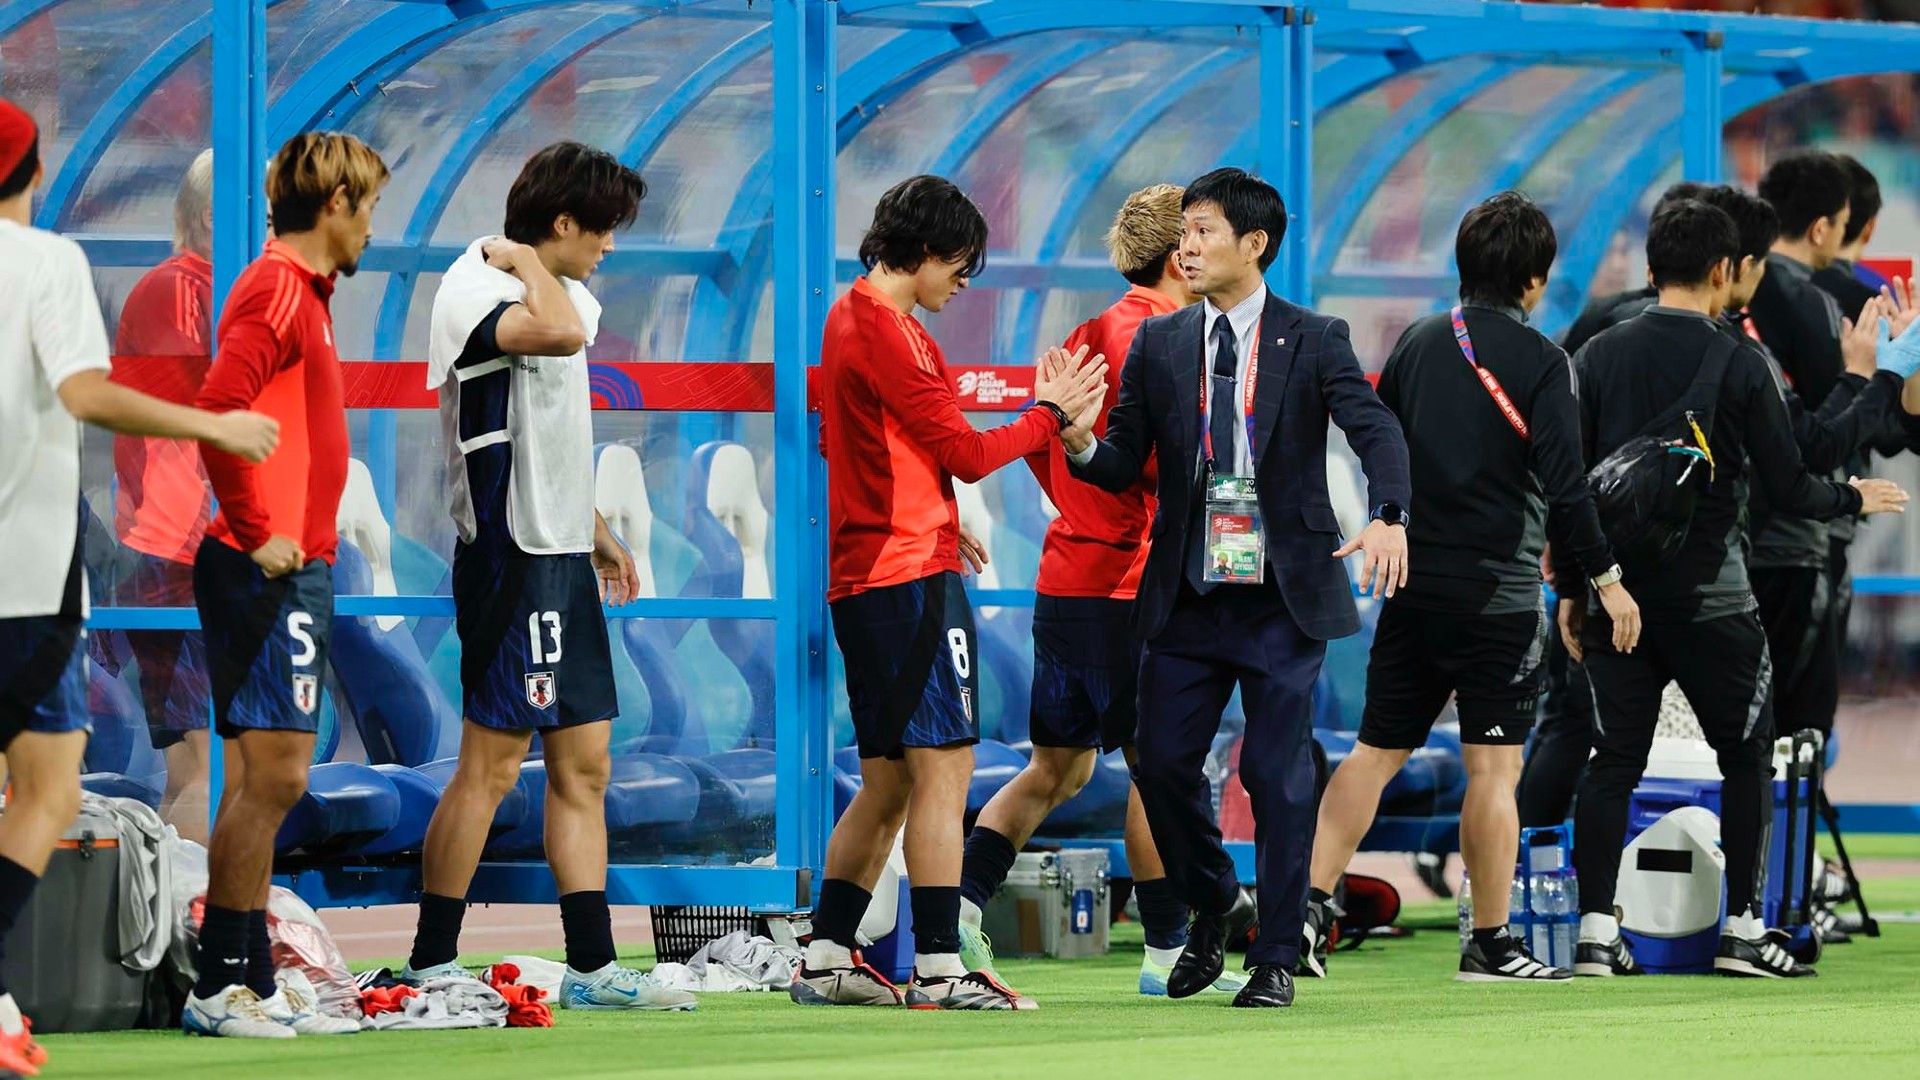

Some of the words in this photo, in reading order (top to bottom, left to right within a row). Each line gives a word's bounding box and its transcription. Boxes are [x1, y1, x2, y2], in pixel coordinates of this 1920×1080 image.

[976, 387, 1029, 397] QUALIFIERS
[287, 611, 316, 666] 5
[528, 610, 562, 664] 13
[947, 628, 970, 679] 8
